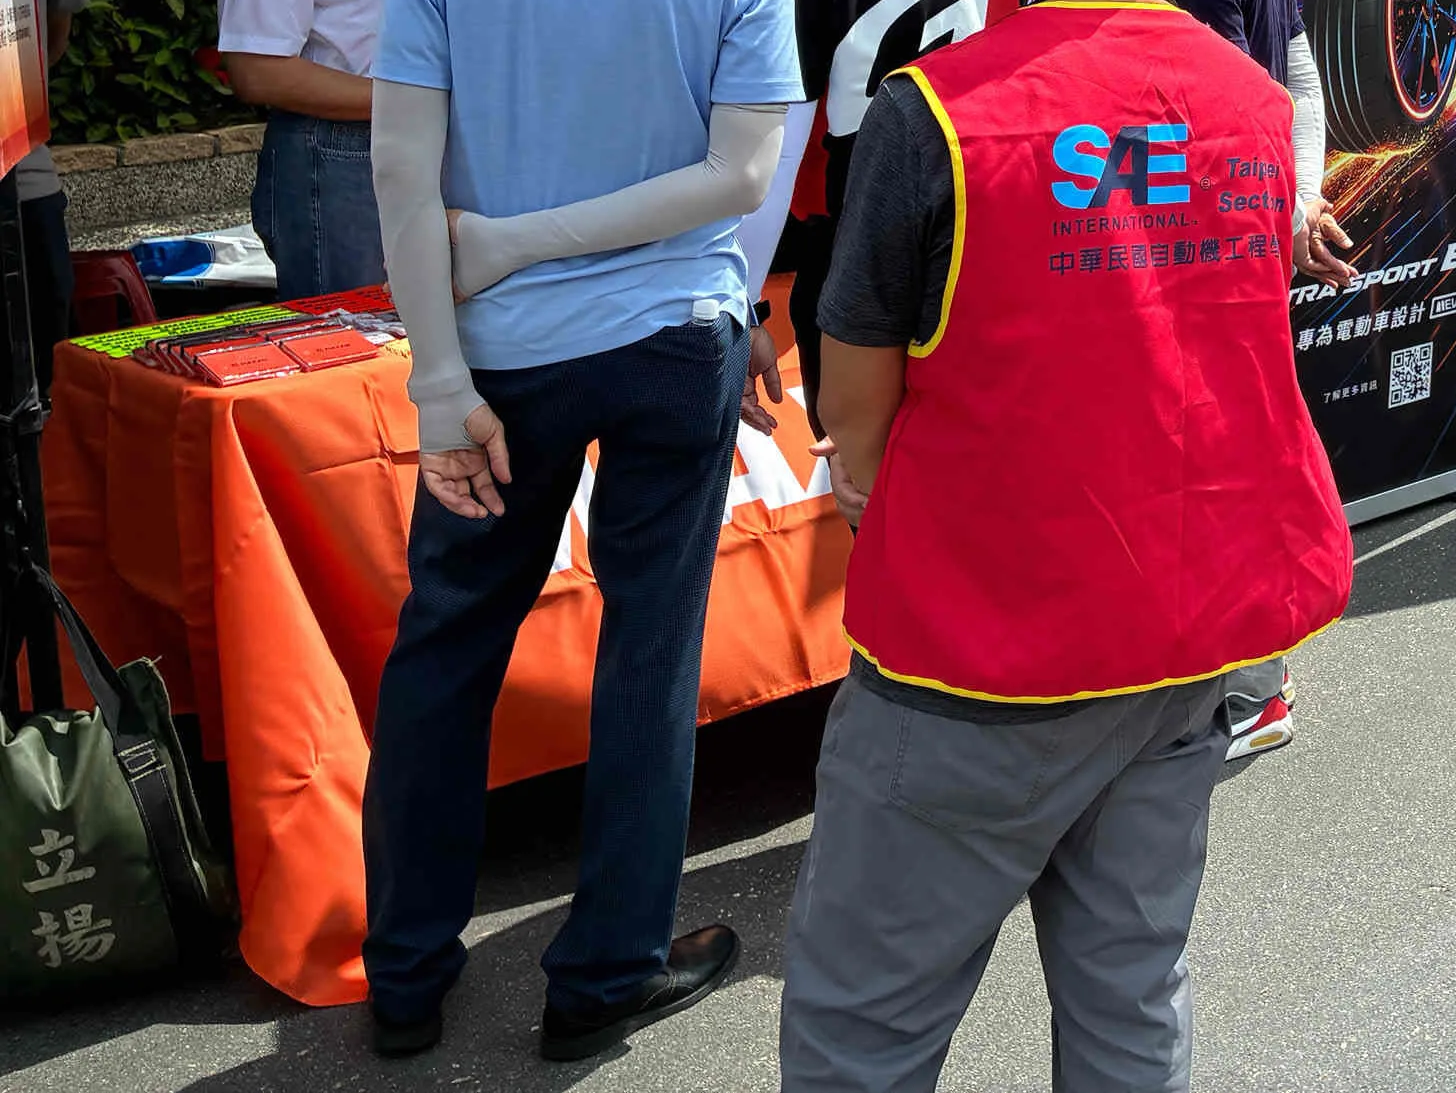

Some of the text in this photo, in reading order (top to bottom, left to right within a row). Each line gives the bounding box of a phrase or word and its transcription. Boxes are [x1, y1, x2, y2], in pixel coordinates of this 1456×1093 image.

[1051, 123, 1190, 209] SAE
[1052, 212, 1190, 237] INTERNATIONAL
[1343, 257, 1438, 295] SPORT
[1295, 301, 1426, 352] 專為電動車設計
[1323, 379, 1378, 404] 了解更多資訊
[22, 828, 116, 968] 立揚
